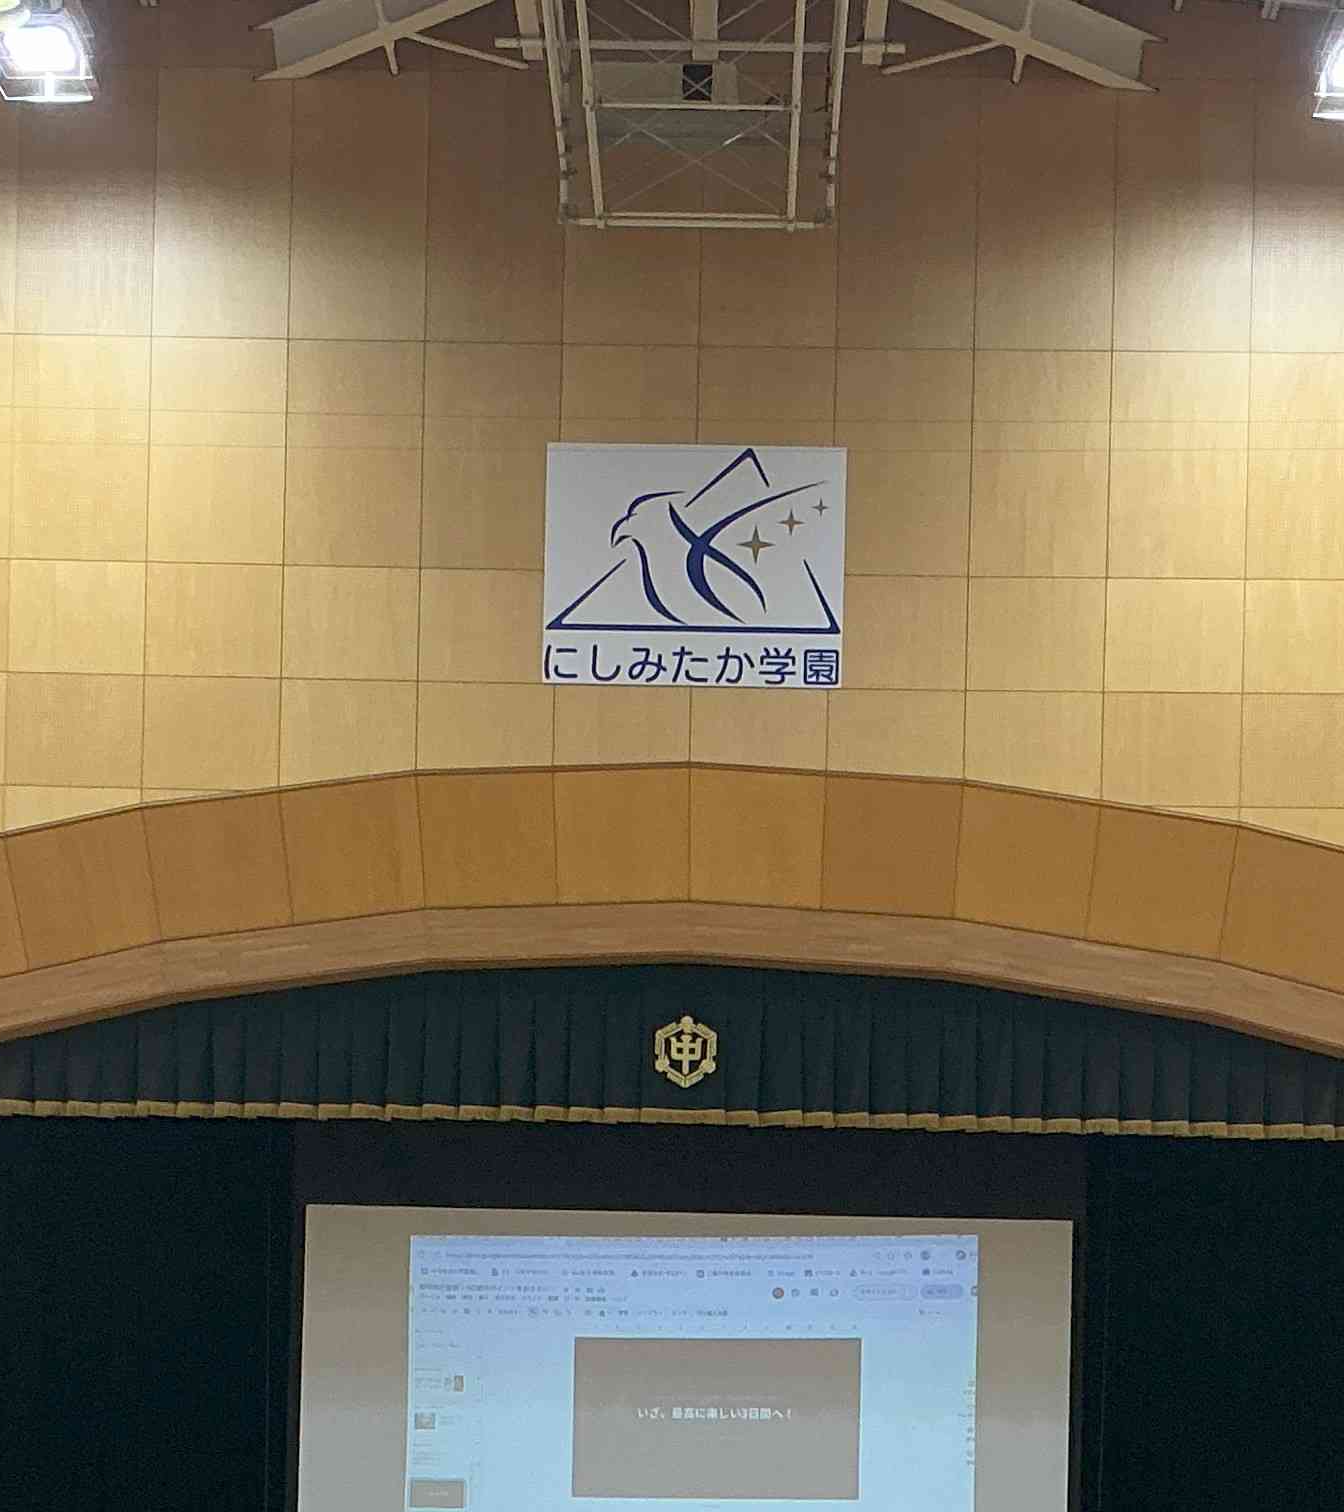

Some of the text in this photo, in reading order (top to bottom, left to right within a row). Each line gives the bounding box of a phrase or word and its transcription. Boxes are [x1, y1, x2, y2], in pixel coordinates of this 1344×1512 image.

[543, 643, 840, 686] にしみたか学園
